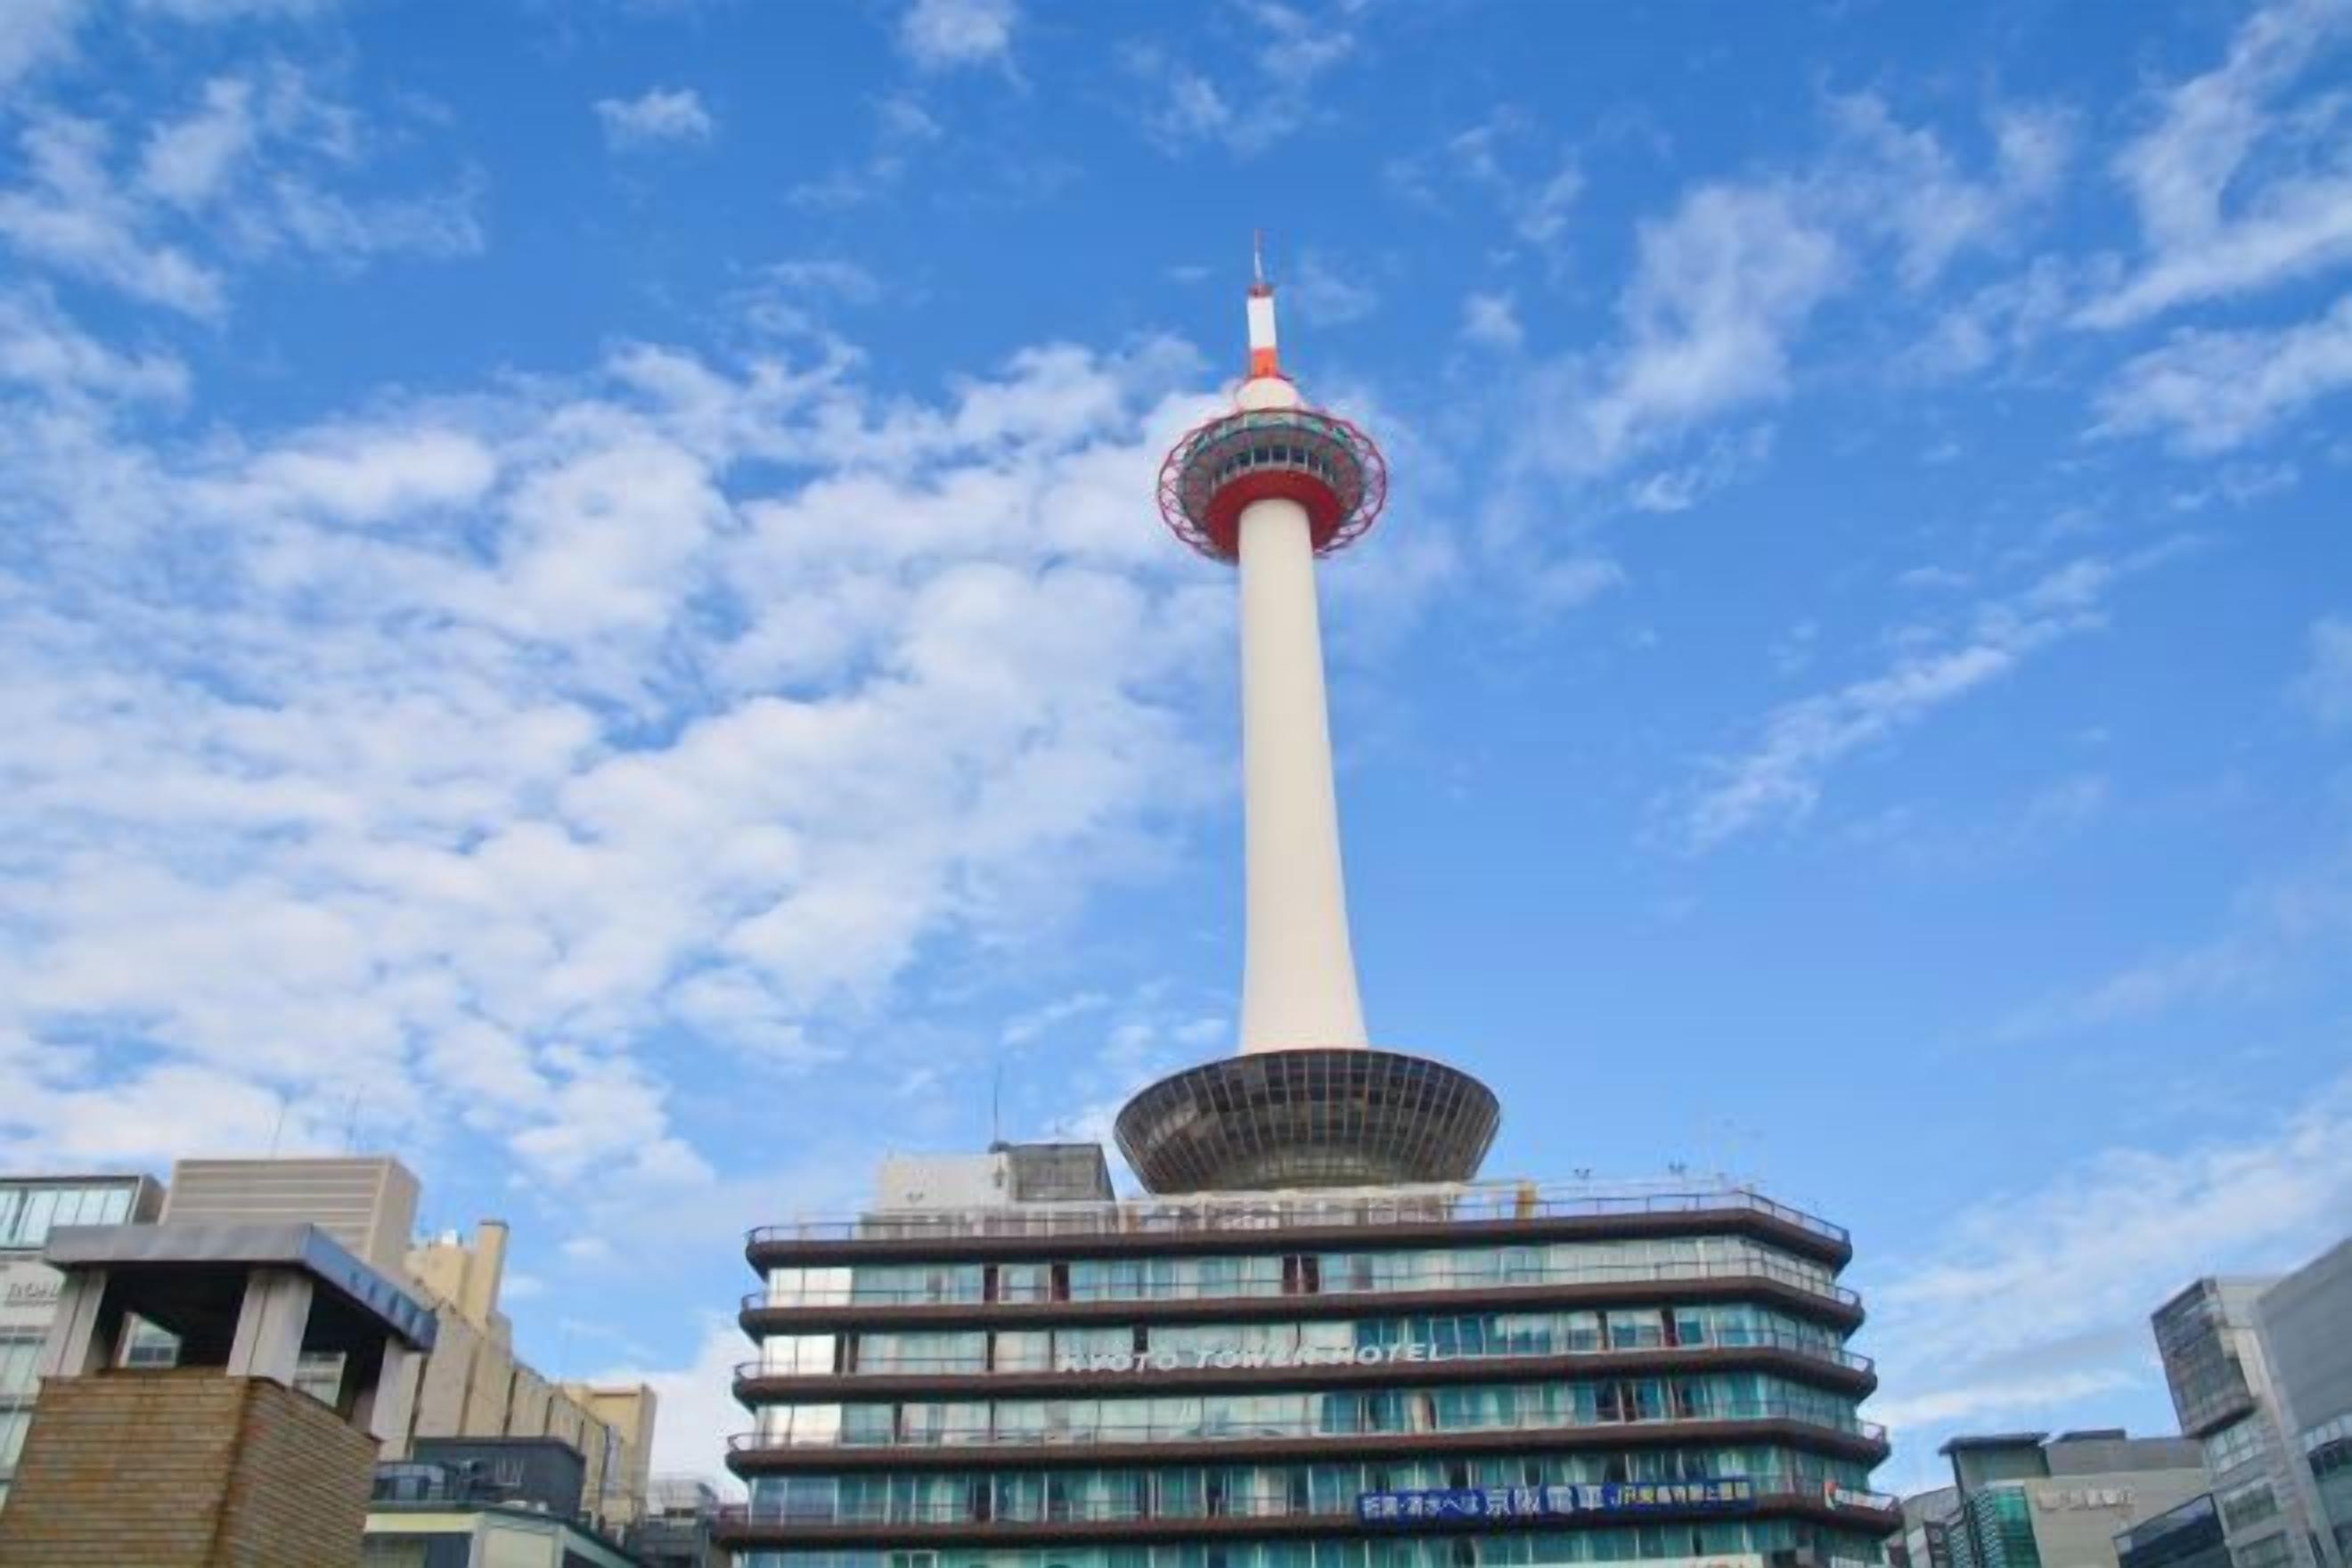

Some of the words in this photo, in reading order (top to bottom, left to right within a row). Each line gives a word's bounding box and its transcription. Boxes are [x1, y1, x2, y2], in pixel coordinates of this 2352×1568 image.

[1055, 1351, 1179, 1373] KYOTO
[1196, 1346, 1316, 1368] TOWER
[1329, 1341, 1454, 1366] HOTEL
